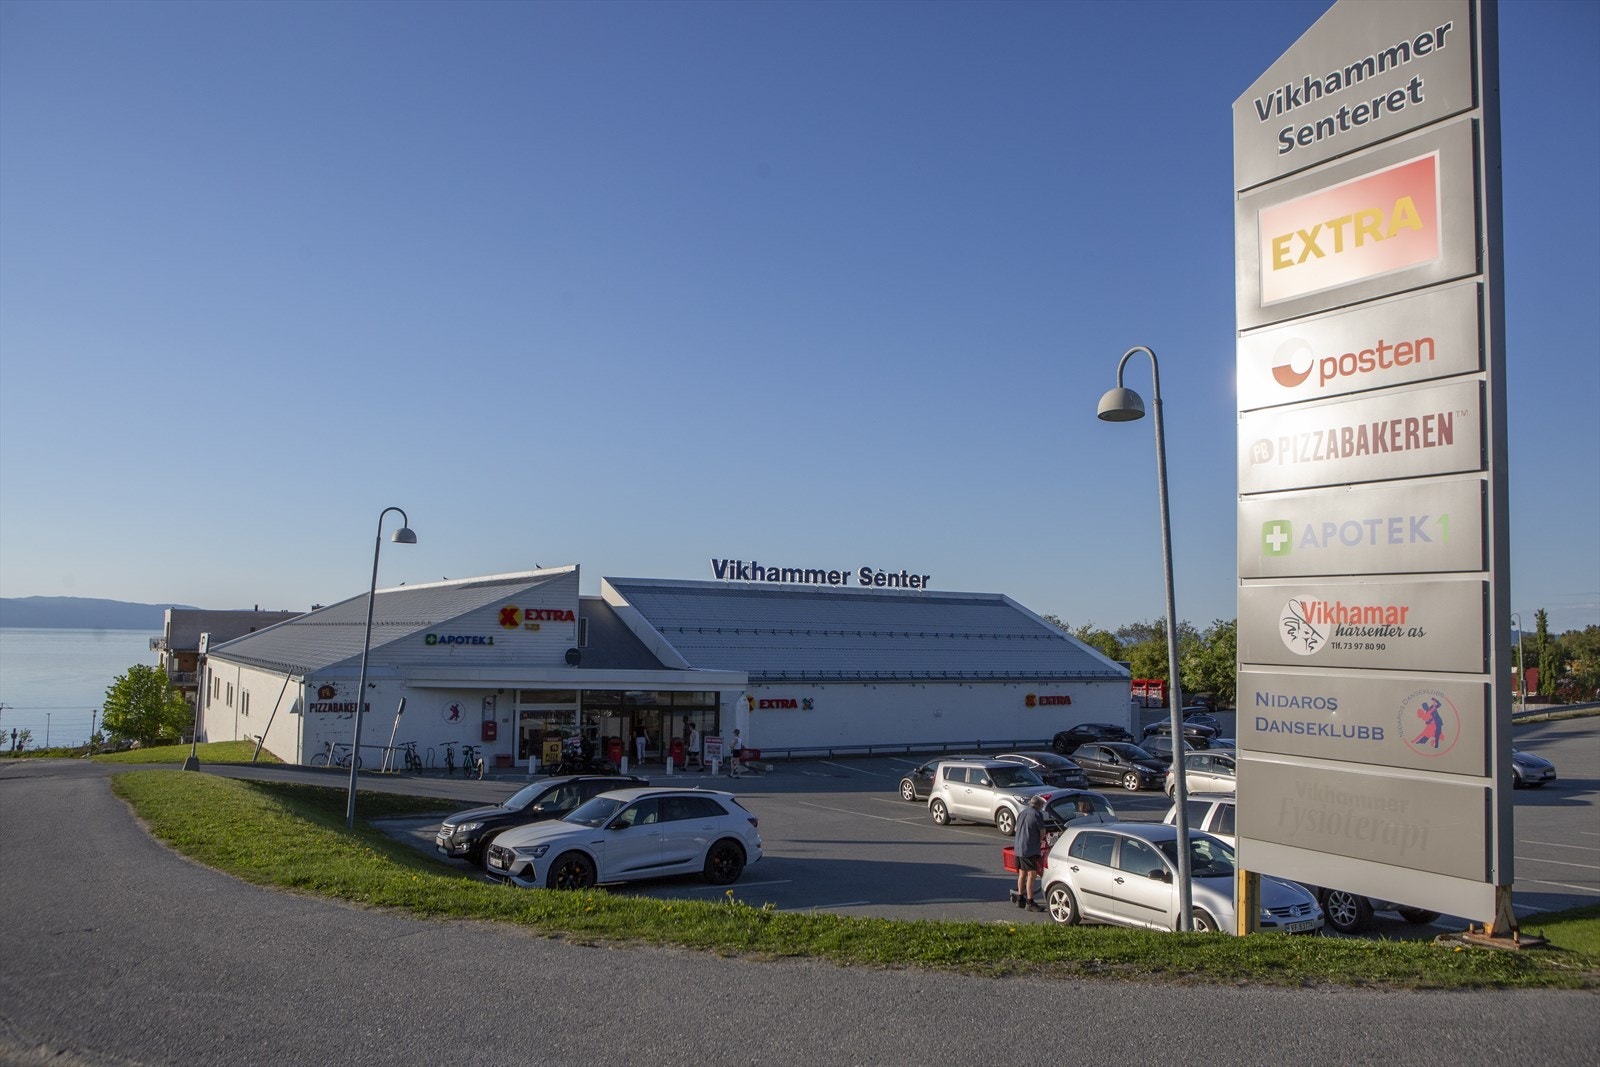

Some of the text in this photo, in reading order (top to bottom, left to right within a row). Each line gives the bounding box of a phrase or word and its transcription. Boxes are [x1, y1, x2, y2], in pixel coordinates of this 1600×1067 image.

[1254, 21, 1453, 122] Vikhammer
[1278, 74, 1424, 156] Senteret
[1272, 195, 1423, 271] EXTRA
[1319, 336, 1435, 387] posten
[1278, 411, 1454, 466] PIZZABAKEREN
[711, 558, 851, 585] Vikhammer
[525, 608, 575, 622] EXTRA
[1302, 600, 1409, 625] Vikhamar
[1335, 621, 1427, 638] hårsenter as
[1331, 642, 1342, 650] Tlf.
[1343, 642, 1352, 650] 73
[1354, 642, 1363, 650] 97
[1376, 643, 1386, 651] 90
[759, 698, 798, 709] EXTRA
[1039, 695, 1072, 706] EXTRA
[1255, 691, 1338, 711] NIDAROS
[1255, 717, 1385, 741] DANSEKLUBB
[1278, 797, 1431, 857] Fysioterapi
